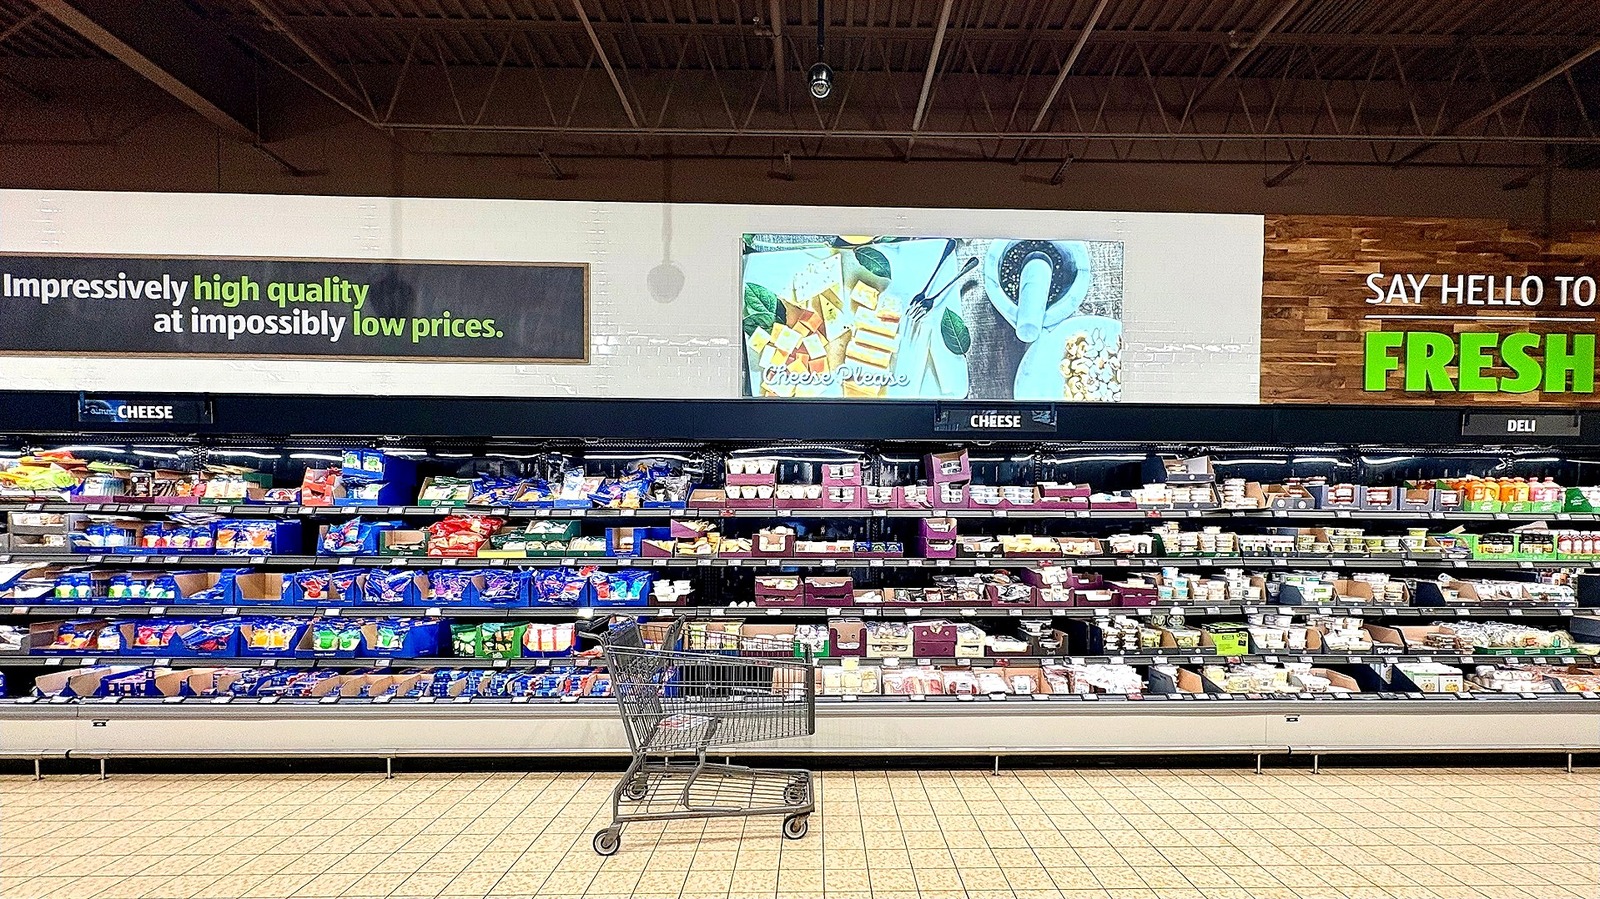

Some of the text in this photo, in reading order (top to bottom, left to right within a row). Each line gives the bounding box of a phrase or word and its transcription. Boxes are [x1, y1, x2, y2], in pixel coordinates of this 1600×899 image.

[3, 272, 369, 309] Impressively high quality
[1365, 273, 1597, 307] SAY HELLO TO
[153, 306, 504, 343] at impossibly low prices.
[762, 364, 911, 387] Cheese Please
[1365, 331, 1596, 393] FRESH
[117, 405, 174, 420] CHEESE
[970, 414, 1021, 428] CHEESE
[1507, 419, 1536, 432] DELI
